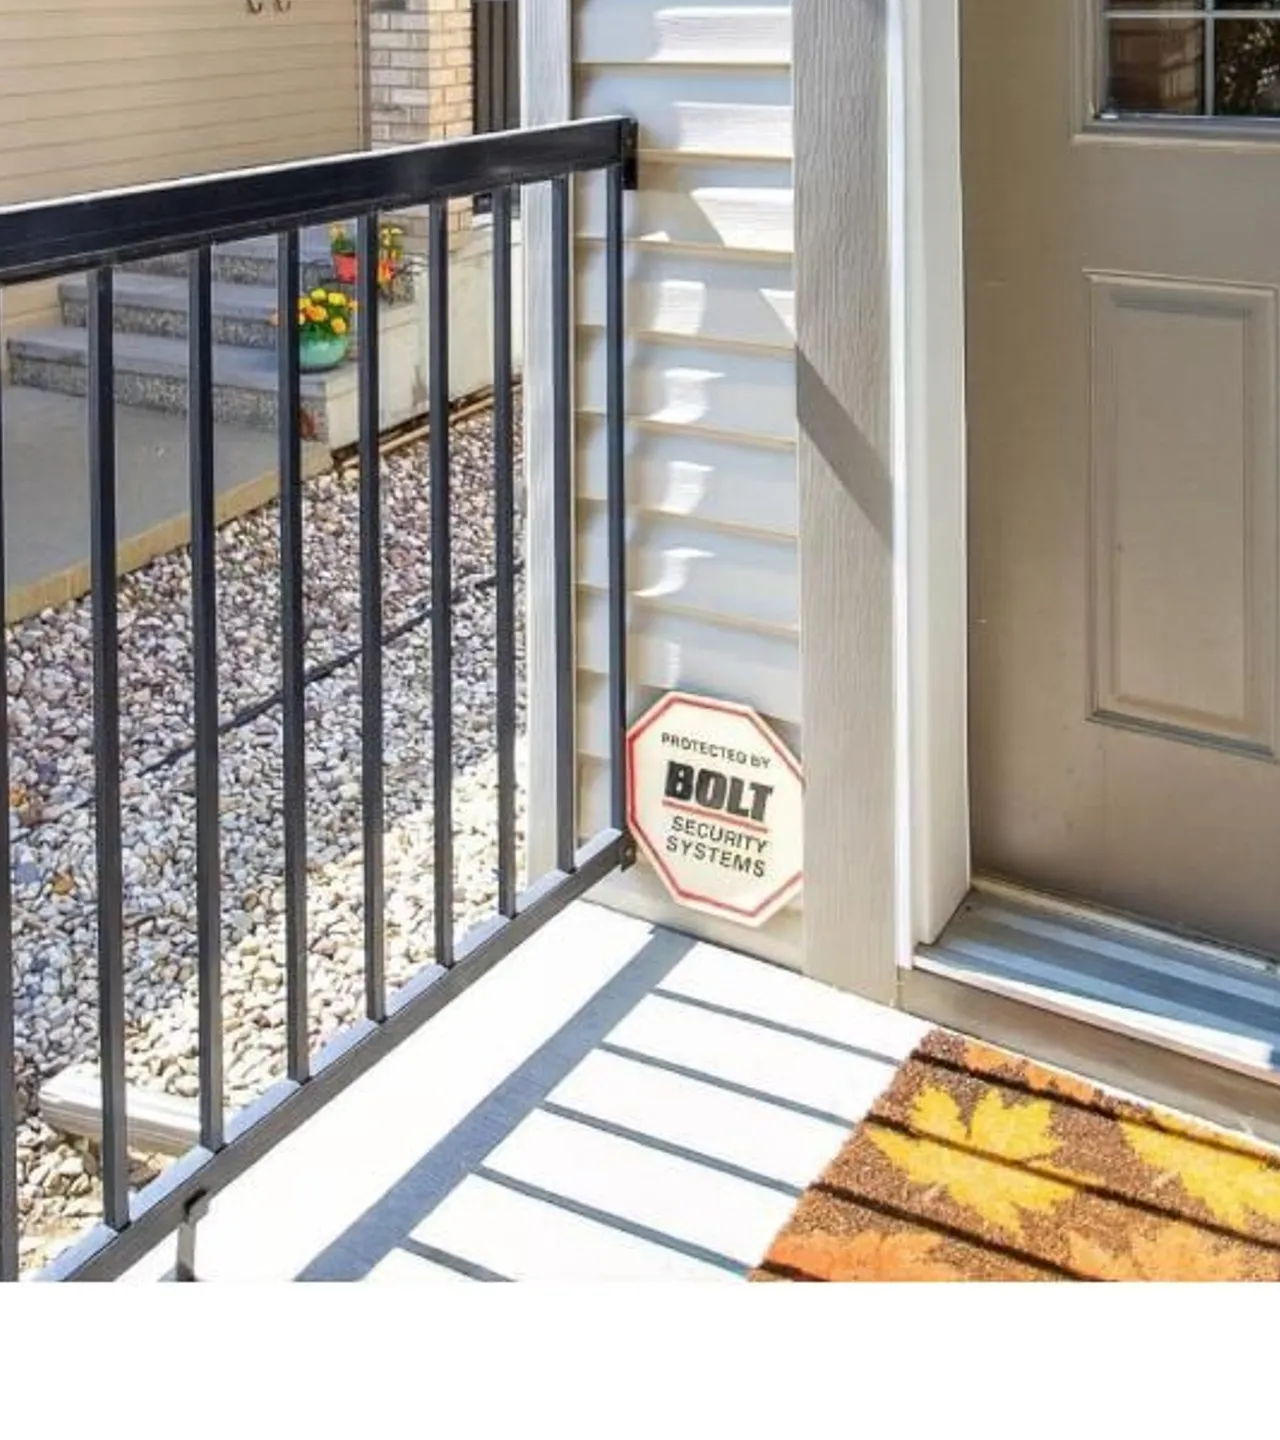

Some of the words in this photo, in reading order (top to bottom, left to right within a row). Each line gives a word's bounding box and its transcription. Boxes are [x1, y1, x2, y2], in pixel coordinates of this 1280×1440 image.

[661, 731, 747, 764] PROTECTED
[750, 755, 770, 769] BY
[665, 760, 774, 822] BOLT
[671, 816, 769, 853] SECURITY
[666, 835, 766, 878] SYSTEMS
